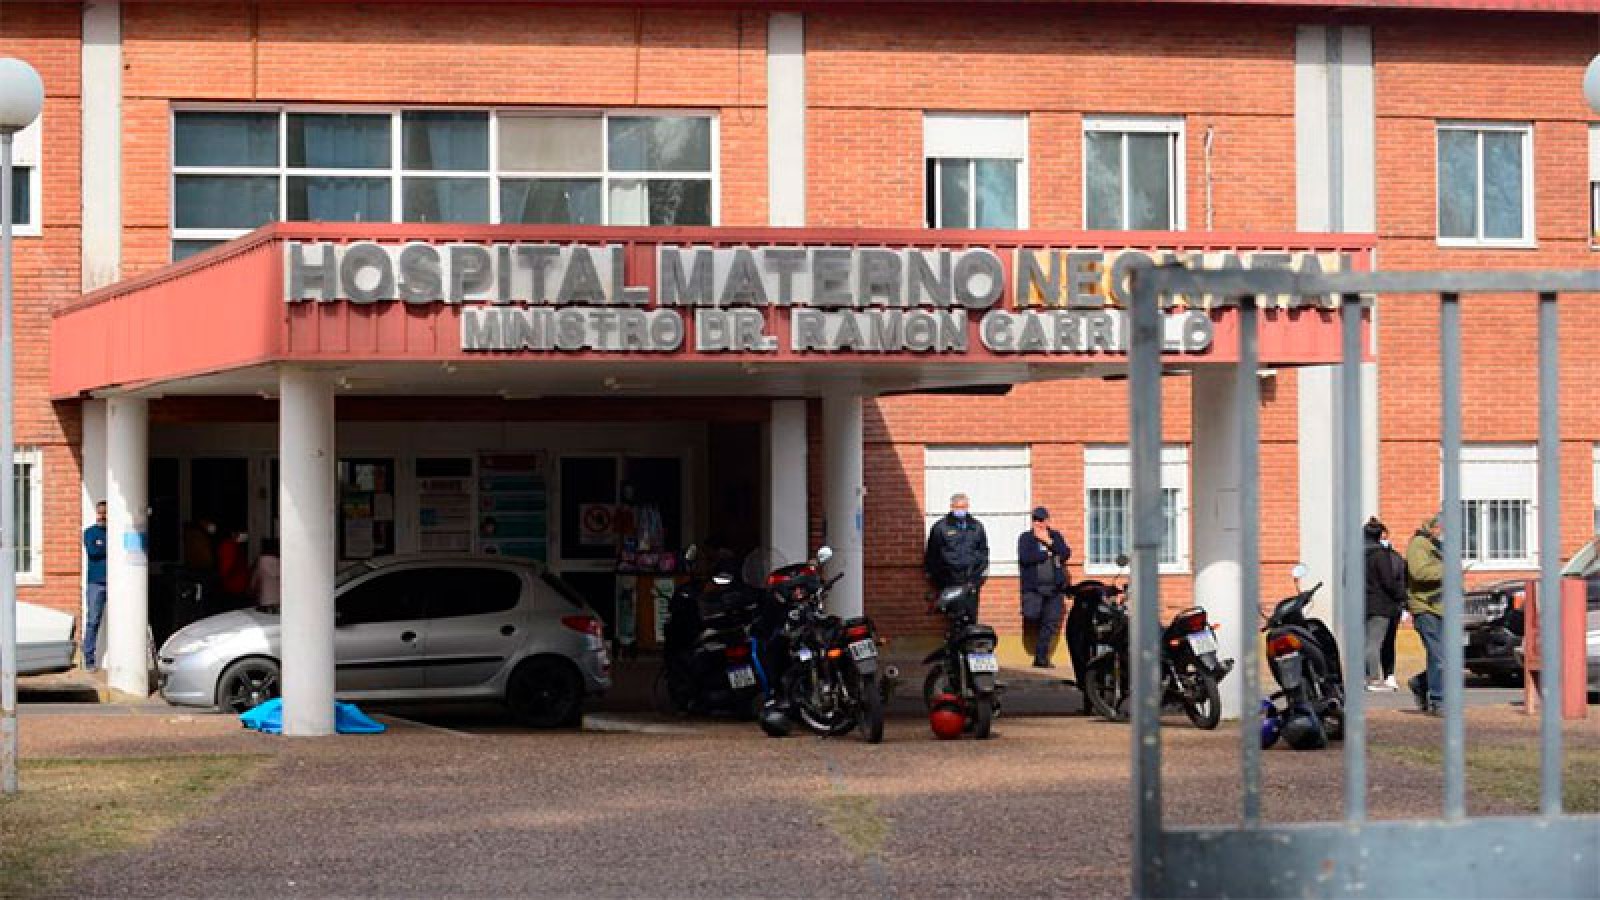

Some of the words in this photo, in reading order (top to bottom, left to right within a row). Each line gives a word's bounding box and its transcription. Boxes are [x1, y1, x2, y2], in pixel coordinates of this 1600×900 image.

[285, 241, 650, 306] HOSPITAL
[656, 246, 1004, 308] MATERNO
[461, 306, 684, 351] MINISTRO
[696, 307, 778, 351] DR.
[791, 307, 968, 351] RAMON
[980, 308, 1213, 352] CARRILO
